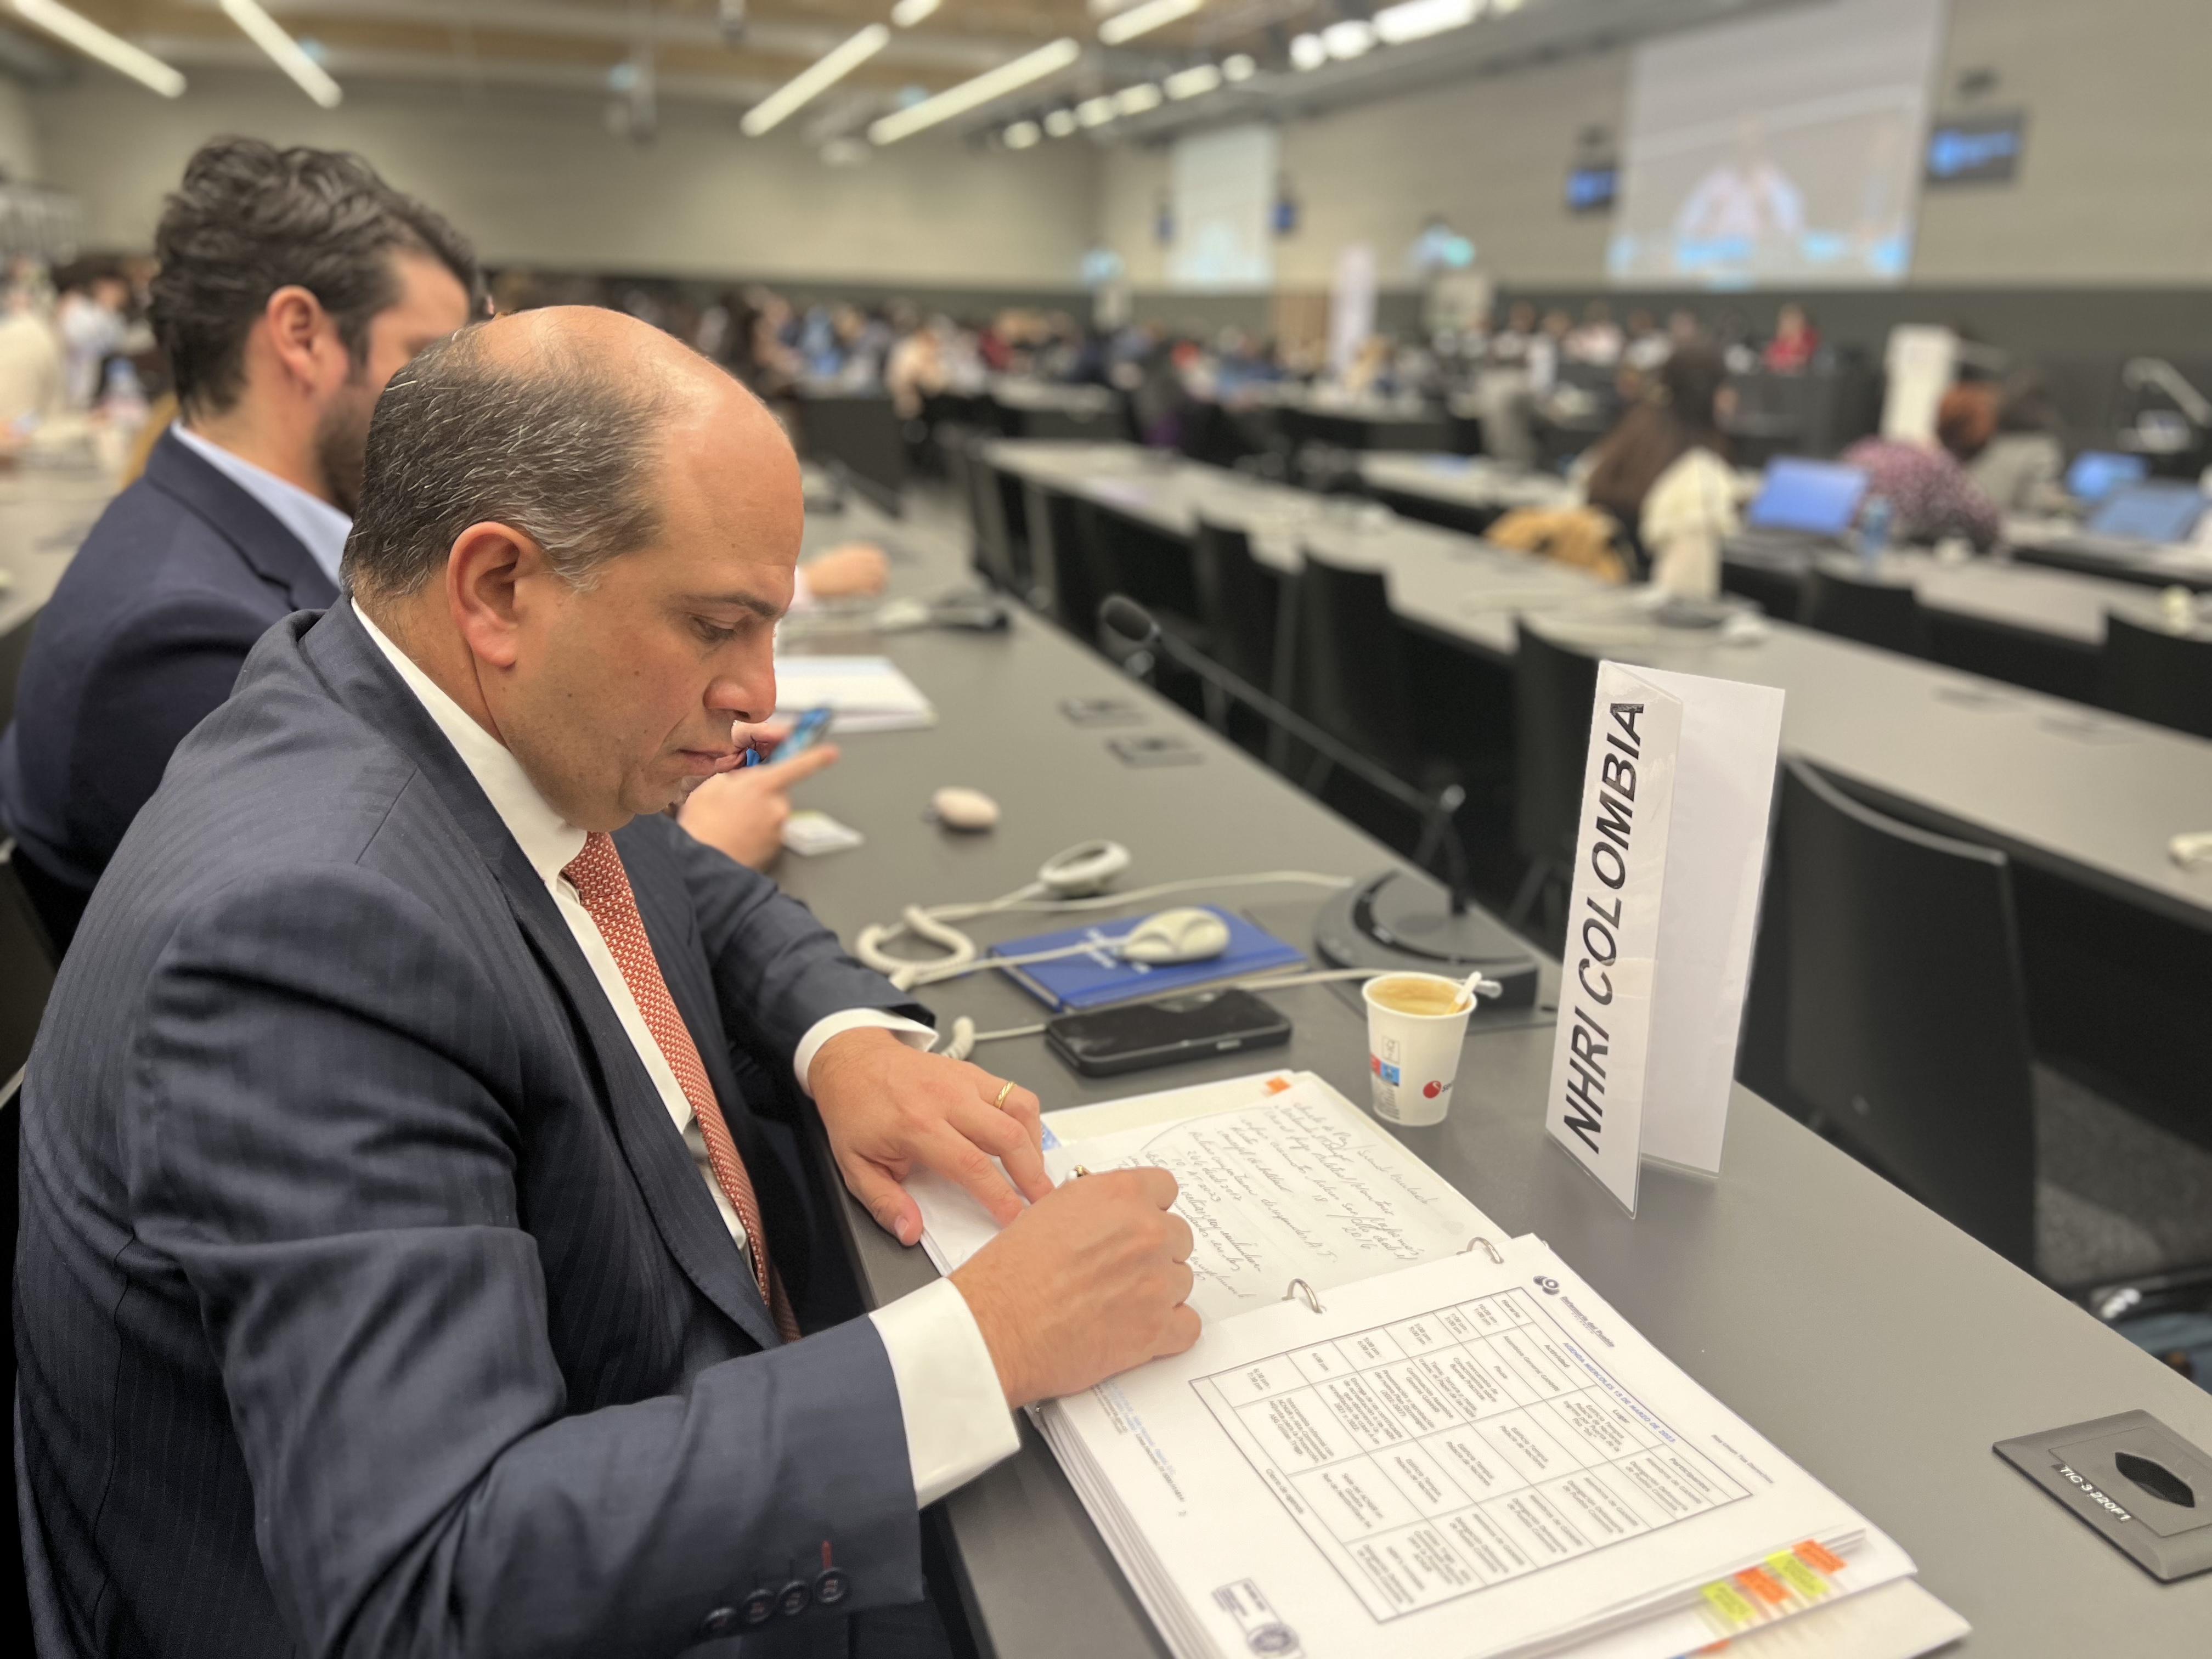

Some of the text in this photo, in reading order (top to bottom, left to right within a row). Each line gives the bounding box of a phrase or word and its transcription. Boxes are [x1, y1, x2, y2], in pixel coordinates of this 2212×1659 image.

[1563, 703, 1644, 1154] NHRI COLOMBIA
[1197, 1183, 1222, 1203] 2023
[1341, 1227, 1378, 1249] 2016
[1501, 1299, 1521, 1318] Horario
[1584, 1321, 1598, 1330] del
[1593, 1329, 1615, 1347] Pueblo
[1502, 1335, 1560, 1391] Asamblea General GANHRI
[1543, 1344, 1570, 1368] Actividad
[1449, 1363, 1466, 1380] Buenas
[1453, 1357, 1497, 1402] Conocimientos sobre
[1465, 1361, 1492, 1388] Intercambio
[1493, 1365, 1508, 1379] Pausa
[1405, 1376, 1424, 1395] General
[1443, 1375, 1461, 1393] Tortura
[1562, 1342, 1585, 1363] AGENDA
[1583, 1363, 1615, 1390] MIERCOLES
[1620, 1396, 1632, 1405] DE
[1628, 1404, 1651, 1422] MARZO
[1649, 1421, 1661, 1430] DE
[1657, 1429, 1676, 1443] 2023
[1574, 1402, 1593, 1419] Palacio
[1612, 1409, 1630, 1423] Lugar
[1668, 1457, 1710, 1492] Participantes
[2061, 1464, 2083, 1483] TIC
[2081, 1482, 2093, 1492] 3
